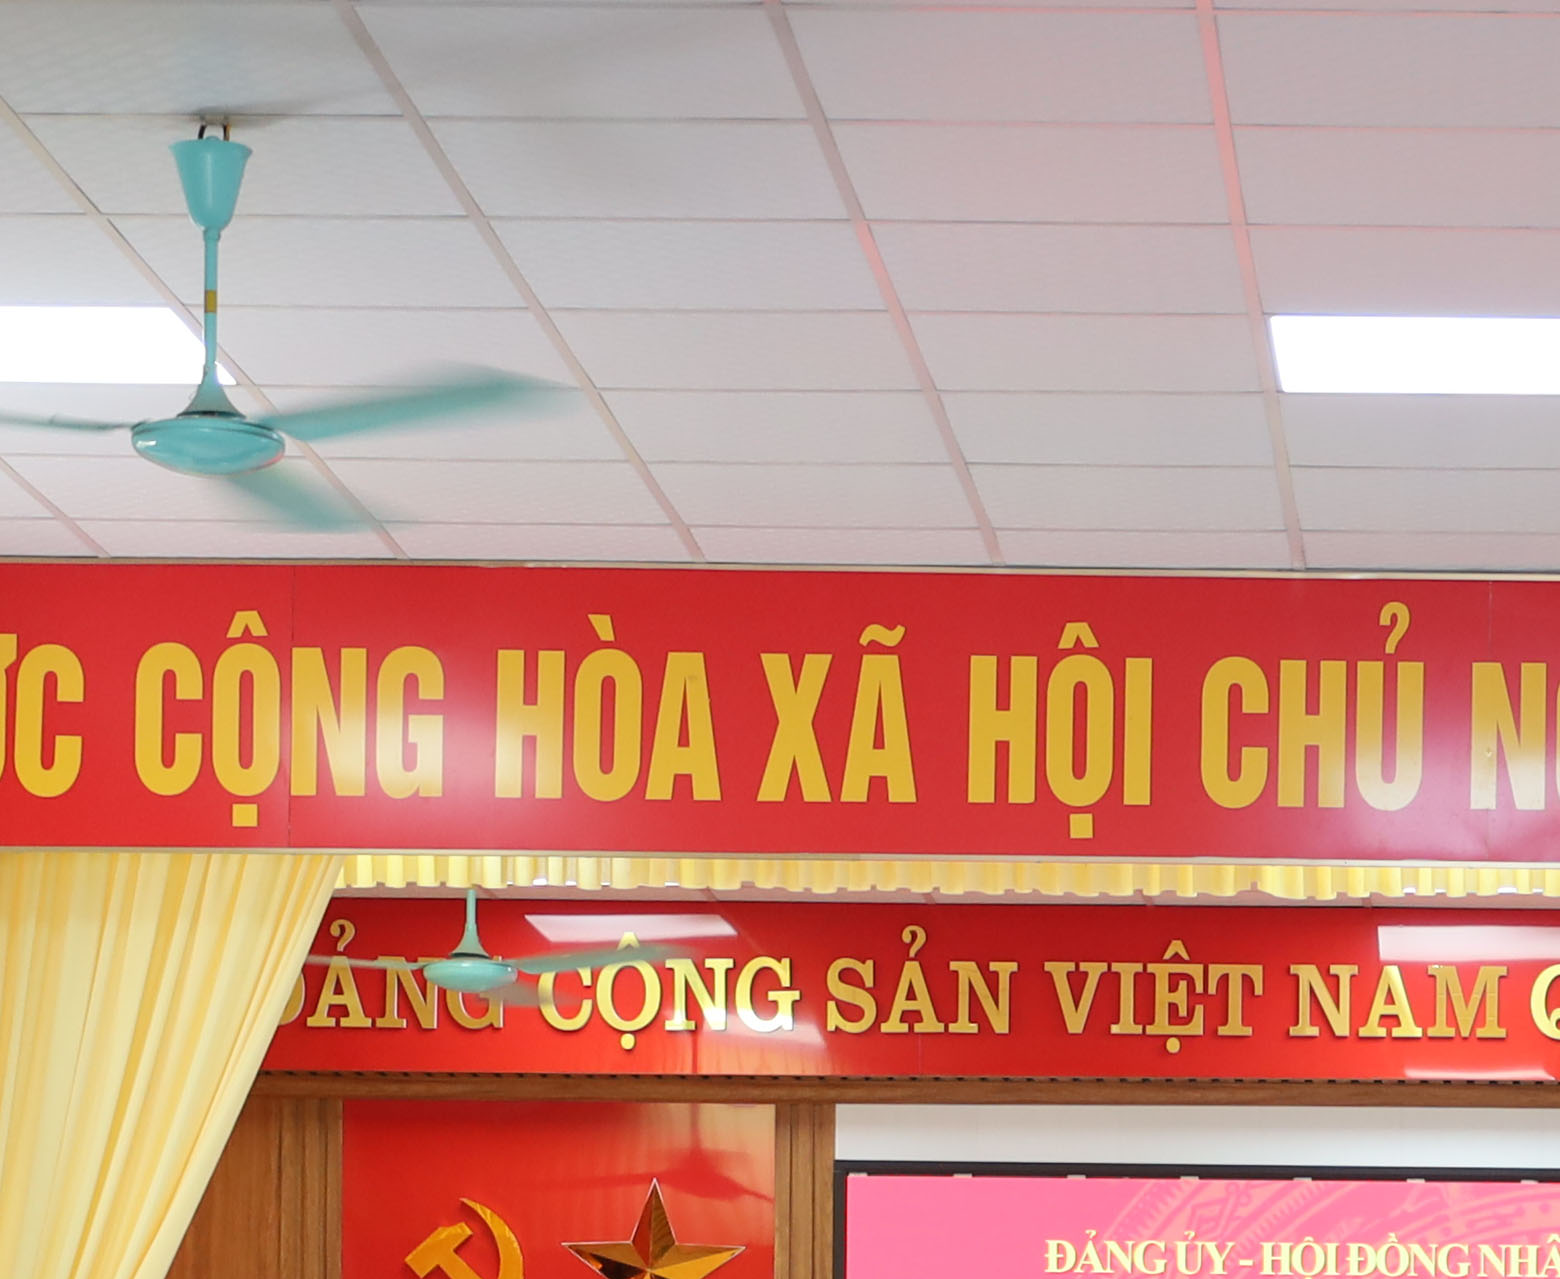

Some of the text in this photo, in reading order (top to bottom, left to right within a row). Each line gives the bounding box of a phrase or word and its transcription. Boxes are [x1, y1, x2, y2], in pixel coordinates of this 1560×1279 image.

[134, 610, 444, 827] CỘNG
[494, 613, 722, 802] HÒA
[756, 623, 917, 803] XÃ
[967, 621, 1153, 839] HỘI
[1200, 601, 1424, 811] CHỦ
[538, 931, 800, 1050] CỘNG
[826, 925, 1018, 1034] SẢN
[1045, 940, 1263, 1053] VIỆT
[1288, 964, 1508, 1039] NAM
[1045, 1230, 1167, 1274] ĐẢNG
[1174, 1231, 1235, 1275] ỦY
[1346, 1233, 1471, 1277] ĐỒNG
